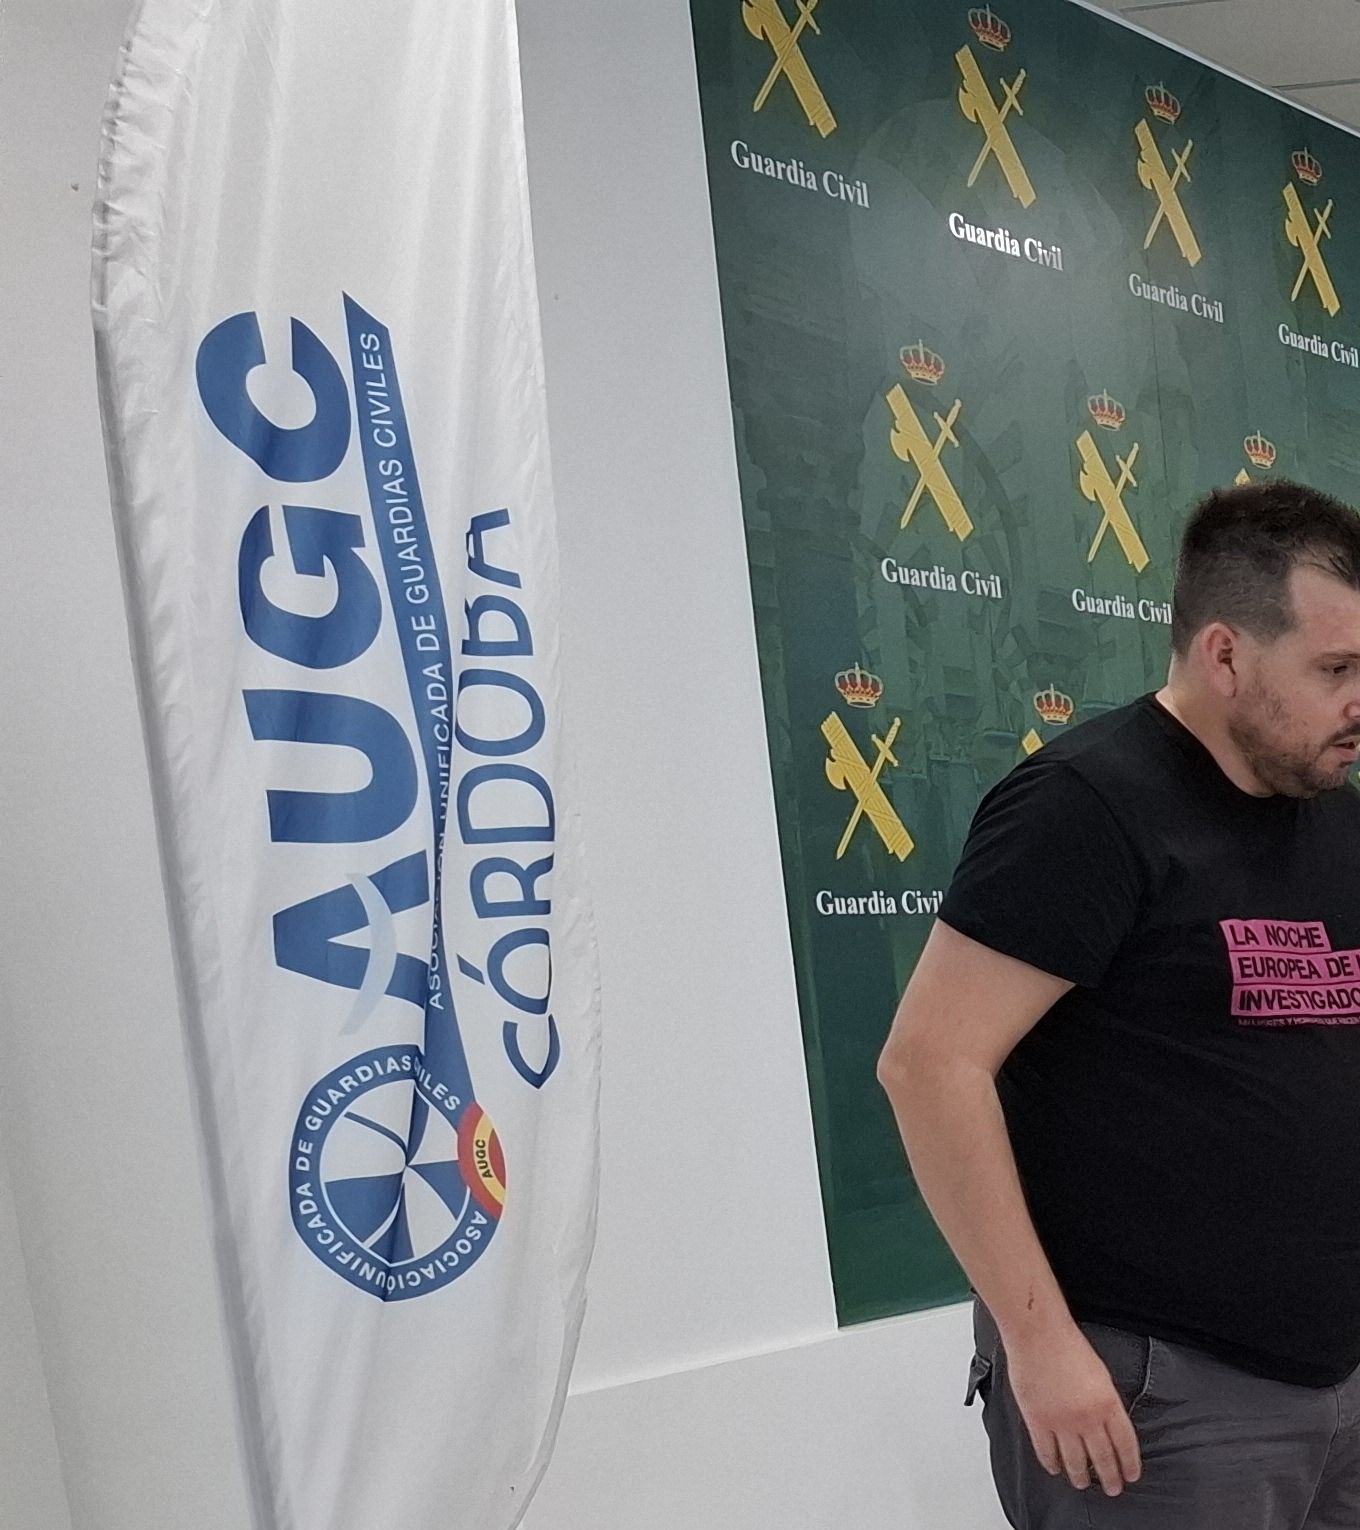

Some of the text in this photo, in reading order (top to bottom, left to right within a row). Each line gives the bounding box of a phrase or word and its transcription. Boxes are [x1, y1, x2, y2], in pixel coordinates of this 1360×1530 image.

[731, 139, 870, 208] Guardia Civil
[949, 212, 1063, 271] Guardia Civil
[1128, 272, 1224, 324] Guardia Civil
[1278, 323, 1359, 368] Guardia Civil
[359, 331, 397, 448] CIVILES
[379, 458, 429, 605] GUARDIAS
[881, 557, 1002, 599] Guardia Civil
[1072, 589, 1172, 625] Guardia Civil
[411, 615, 440, 652] DE
[195, 310, 432, 1008] AUGC
[816, 890, 944, 916] Guardia Civil
[1228, 925, 1325, 949] LA NOCHE
[1237, 956, 1322, 980] EUROPEA
[1324, 957, 1354, 978] DE
[304, 1054, 412, 1132] GUARDIAS
[295, 1139, 313, 1172] DE
[475, 1138, 494, 1180] AUGC
[386, 1210, 488, 1296] ASOCIACIÓ
